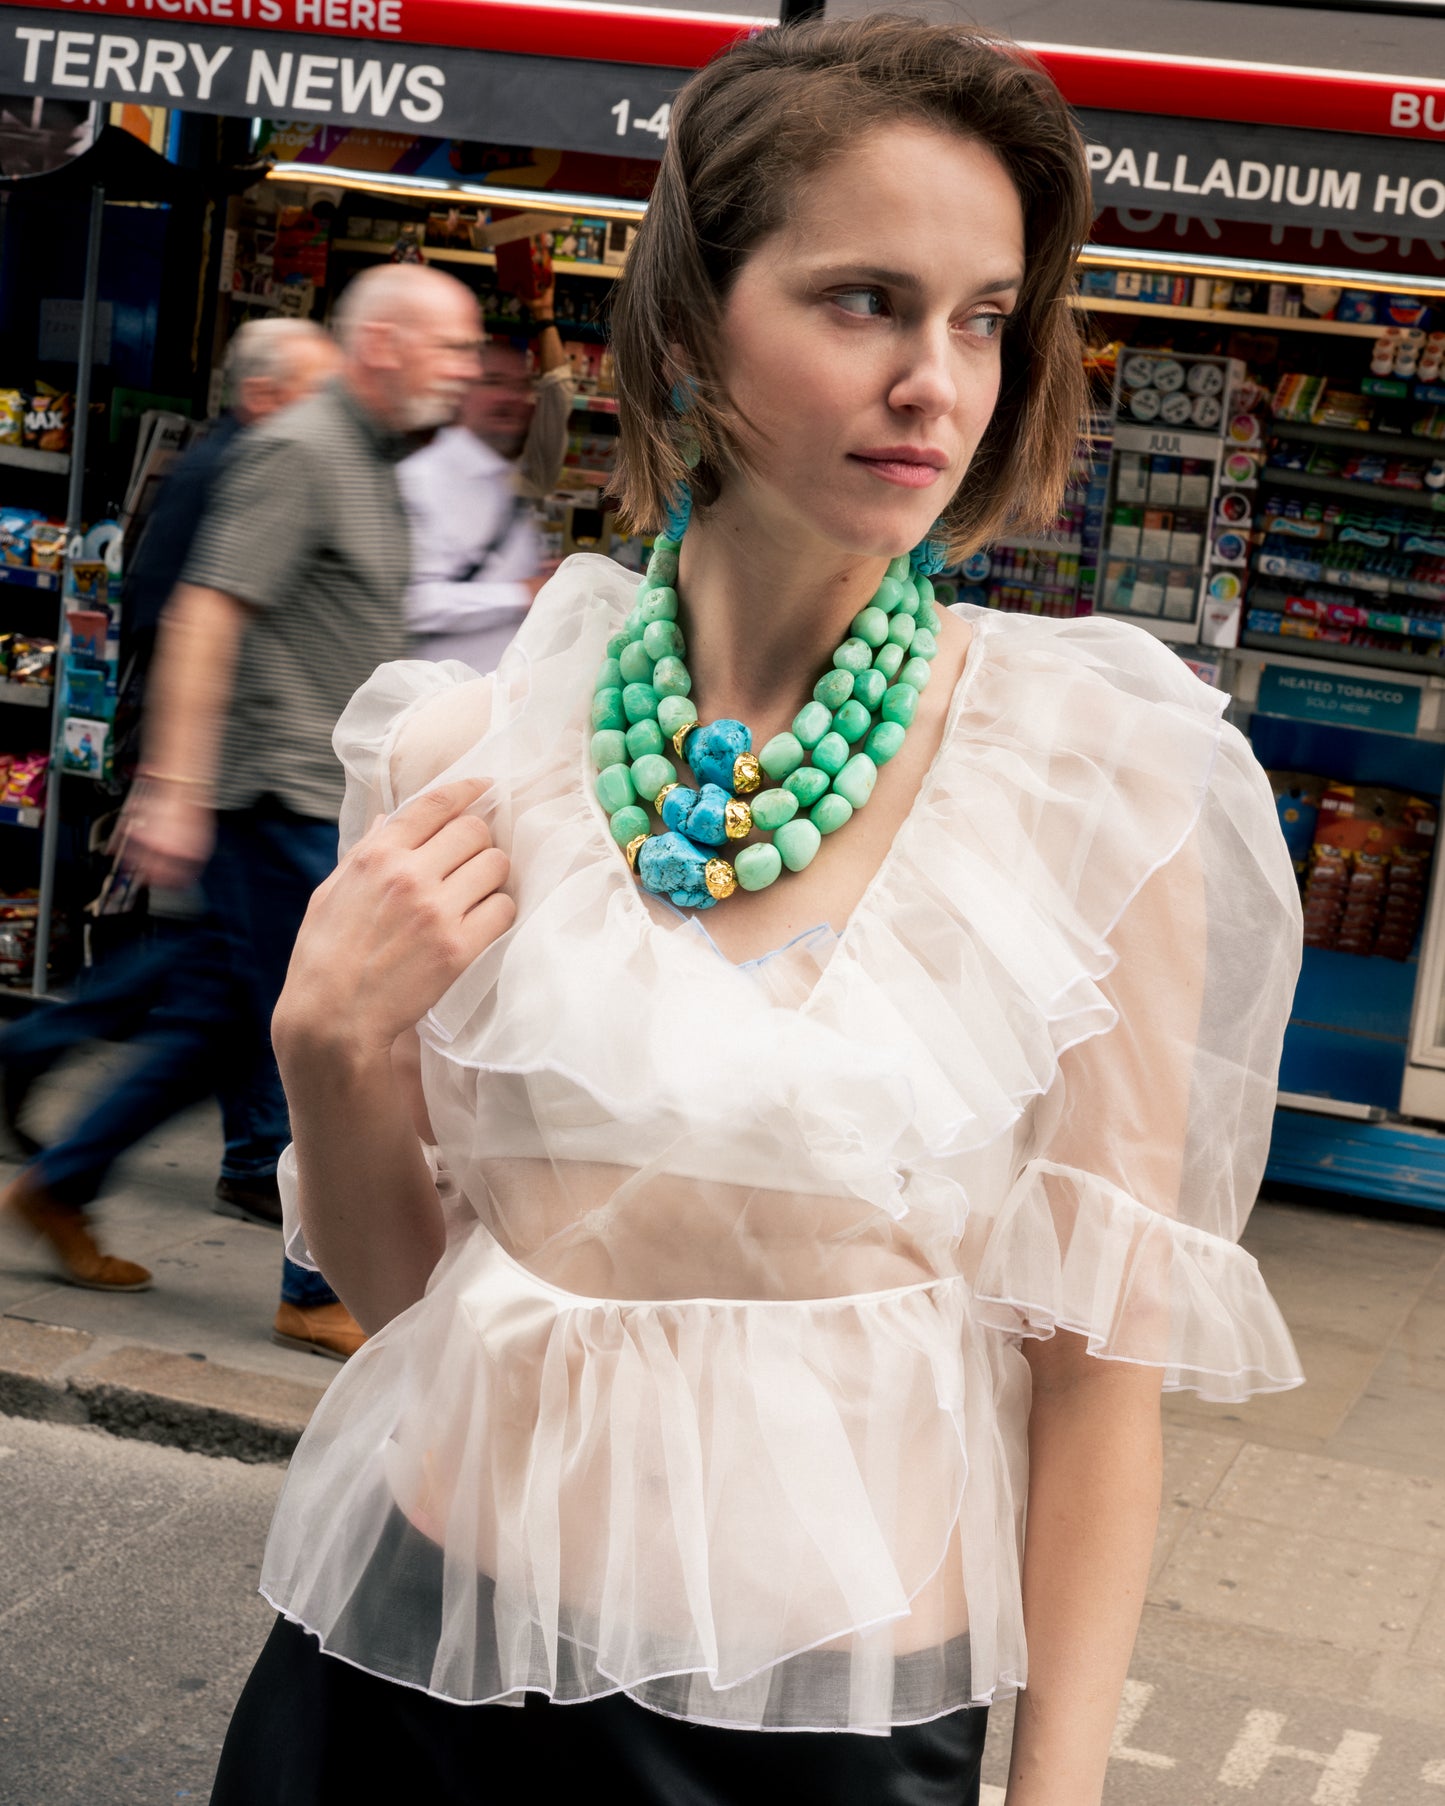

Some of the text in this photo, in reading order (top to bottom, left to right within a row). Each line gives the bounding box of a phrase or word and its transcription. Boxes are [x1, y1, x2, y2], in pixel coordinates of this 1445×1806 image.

[125, 0, 402, 33] KETS HERE
[15, 26, 446, 123] TERRY NEWS
[611, 98, 671, 140] 1-4
[1085, 144, 1445, 219] PALLADIUM HO
[1278, 675, 1404, 705] HEATED TOBACCO
